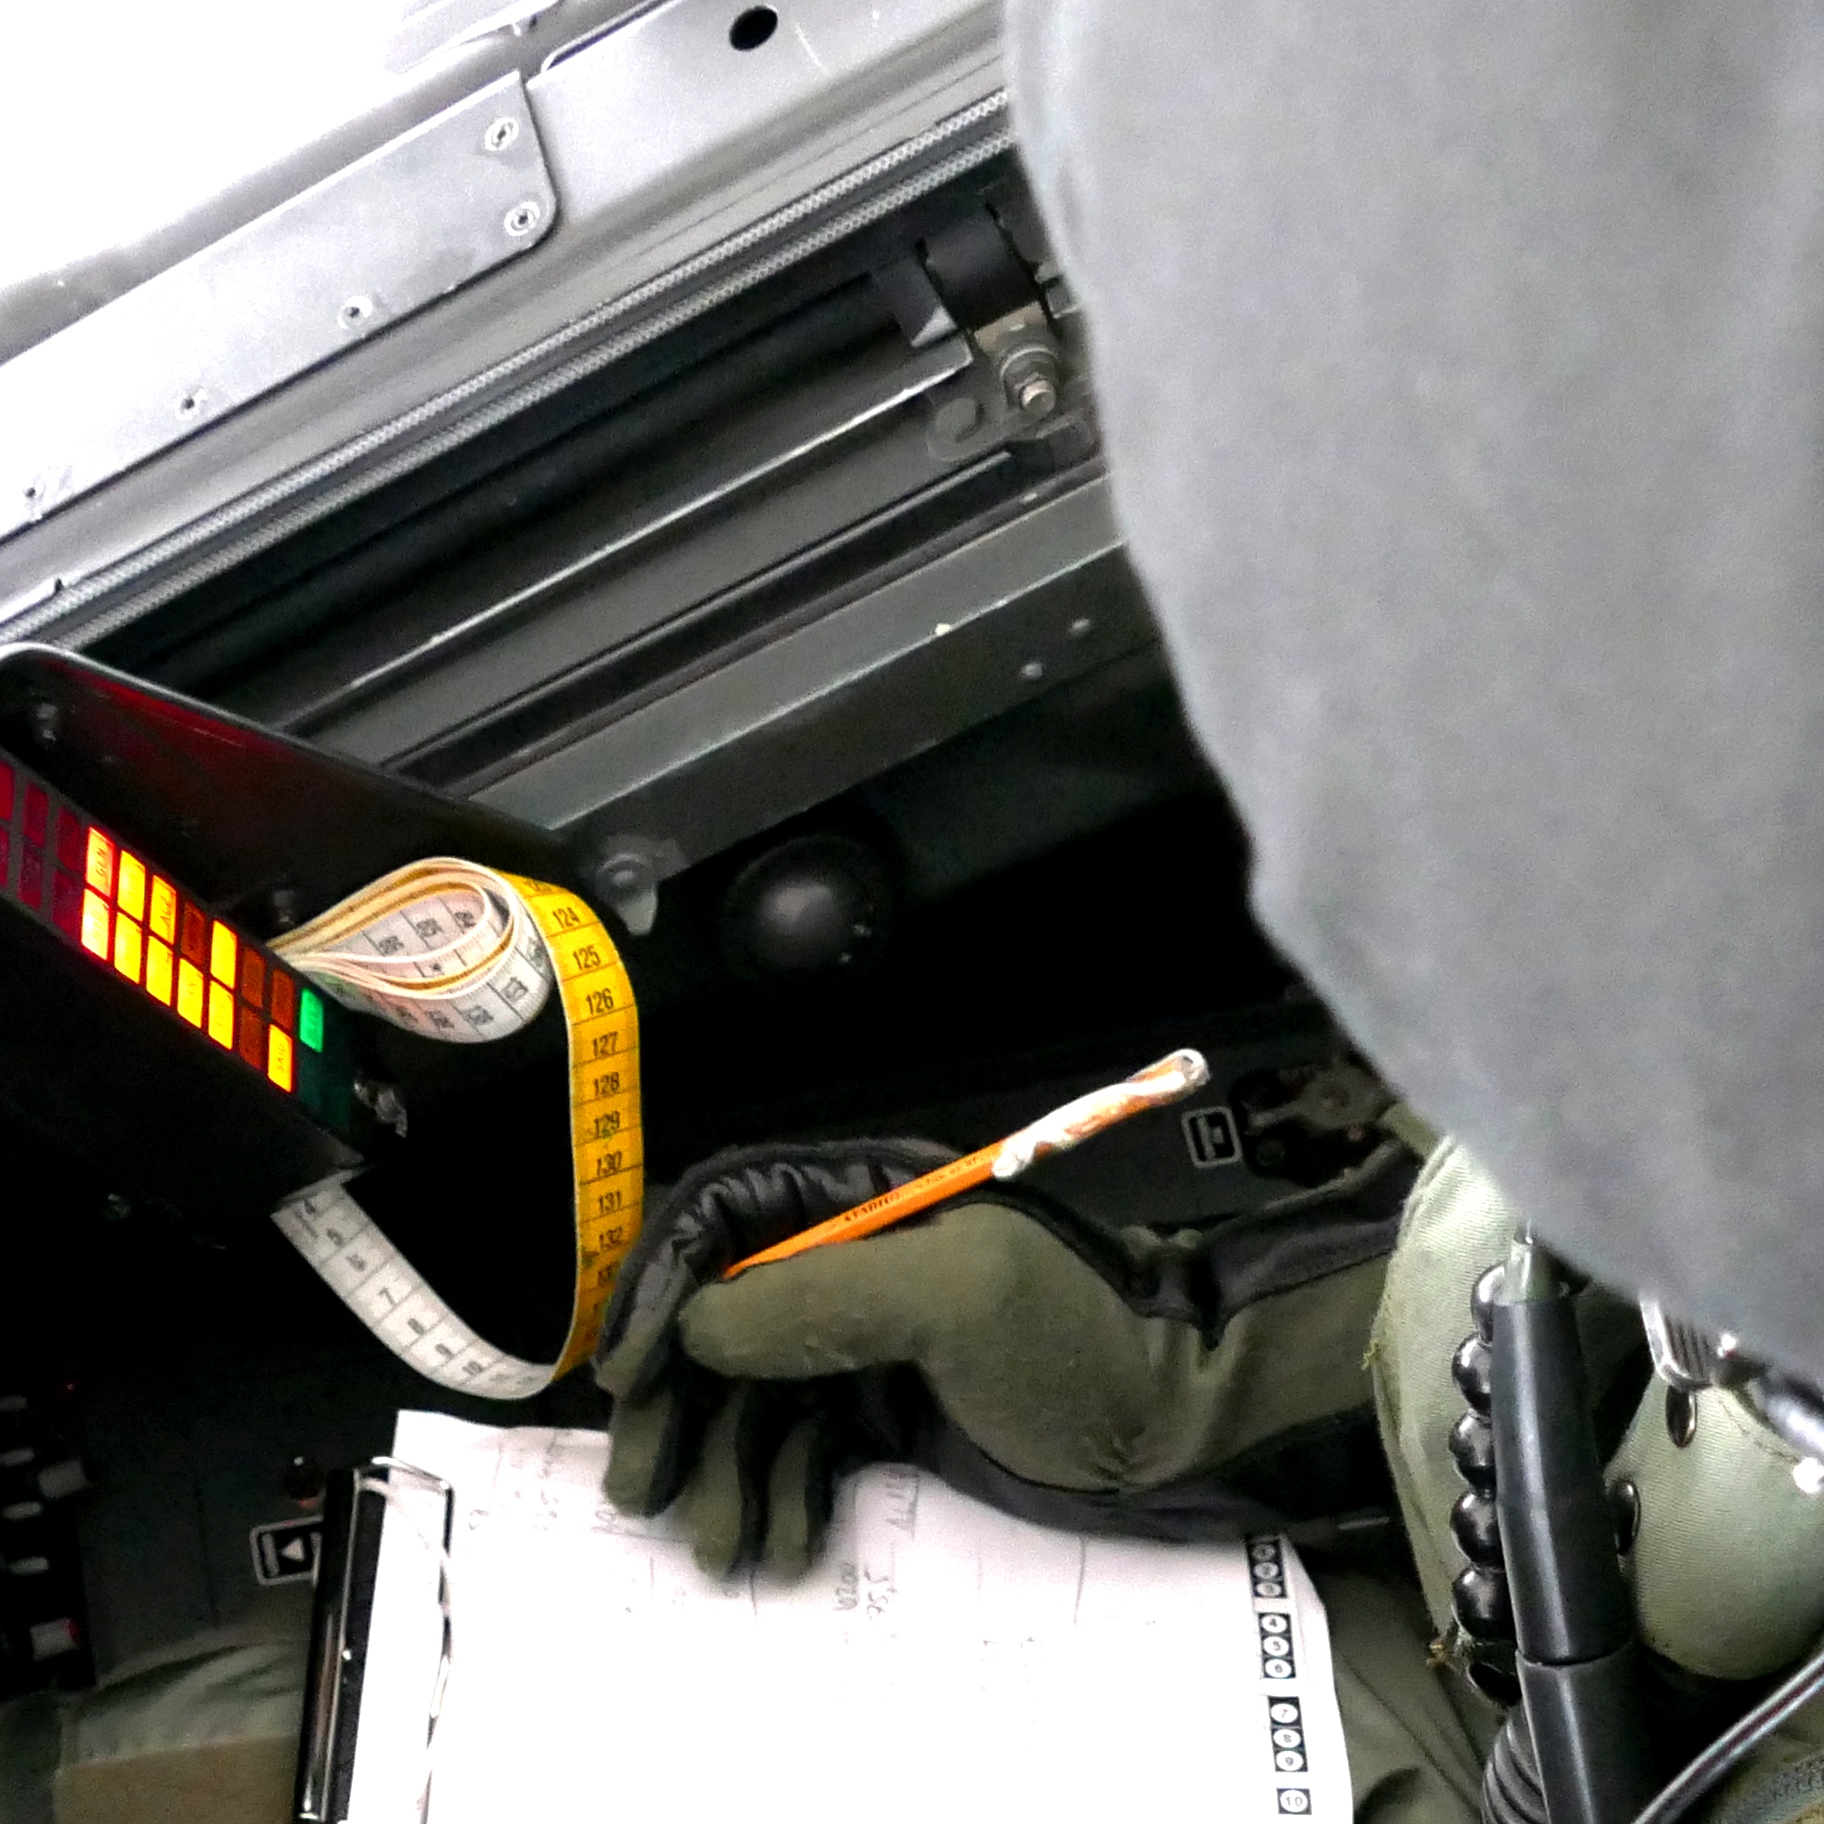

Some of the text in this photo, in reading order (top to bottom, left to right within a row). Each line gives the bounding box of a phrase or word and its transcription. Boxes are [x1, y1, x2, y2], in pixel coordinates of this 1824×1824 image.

[553, 906, 578, 925] 124
[573, 948, 600, 969] 125
[586, 990, 613, 1010] 126
[592, 1033, 618, 1053] 127
[593, 1072, 620, 1091] 128
[594, 1110, 620, 1131] 129
[595, 1152, 622, 1173] 130
[598, 1191, 621, 1210] 131
